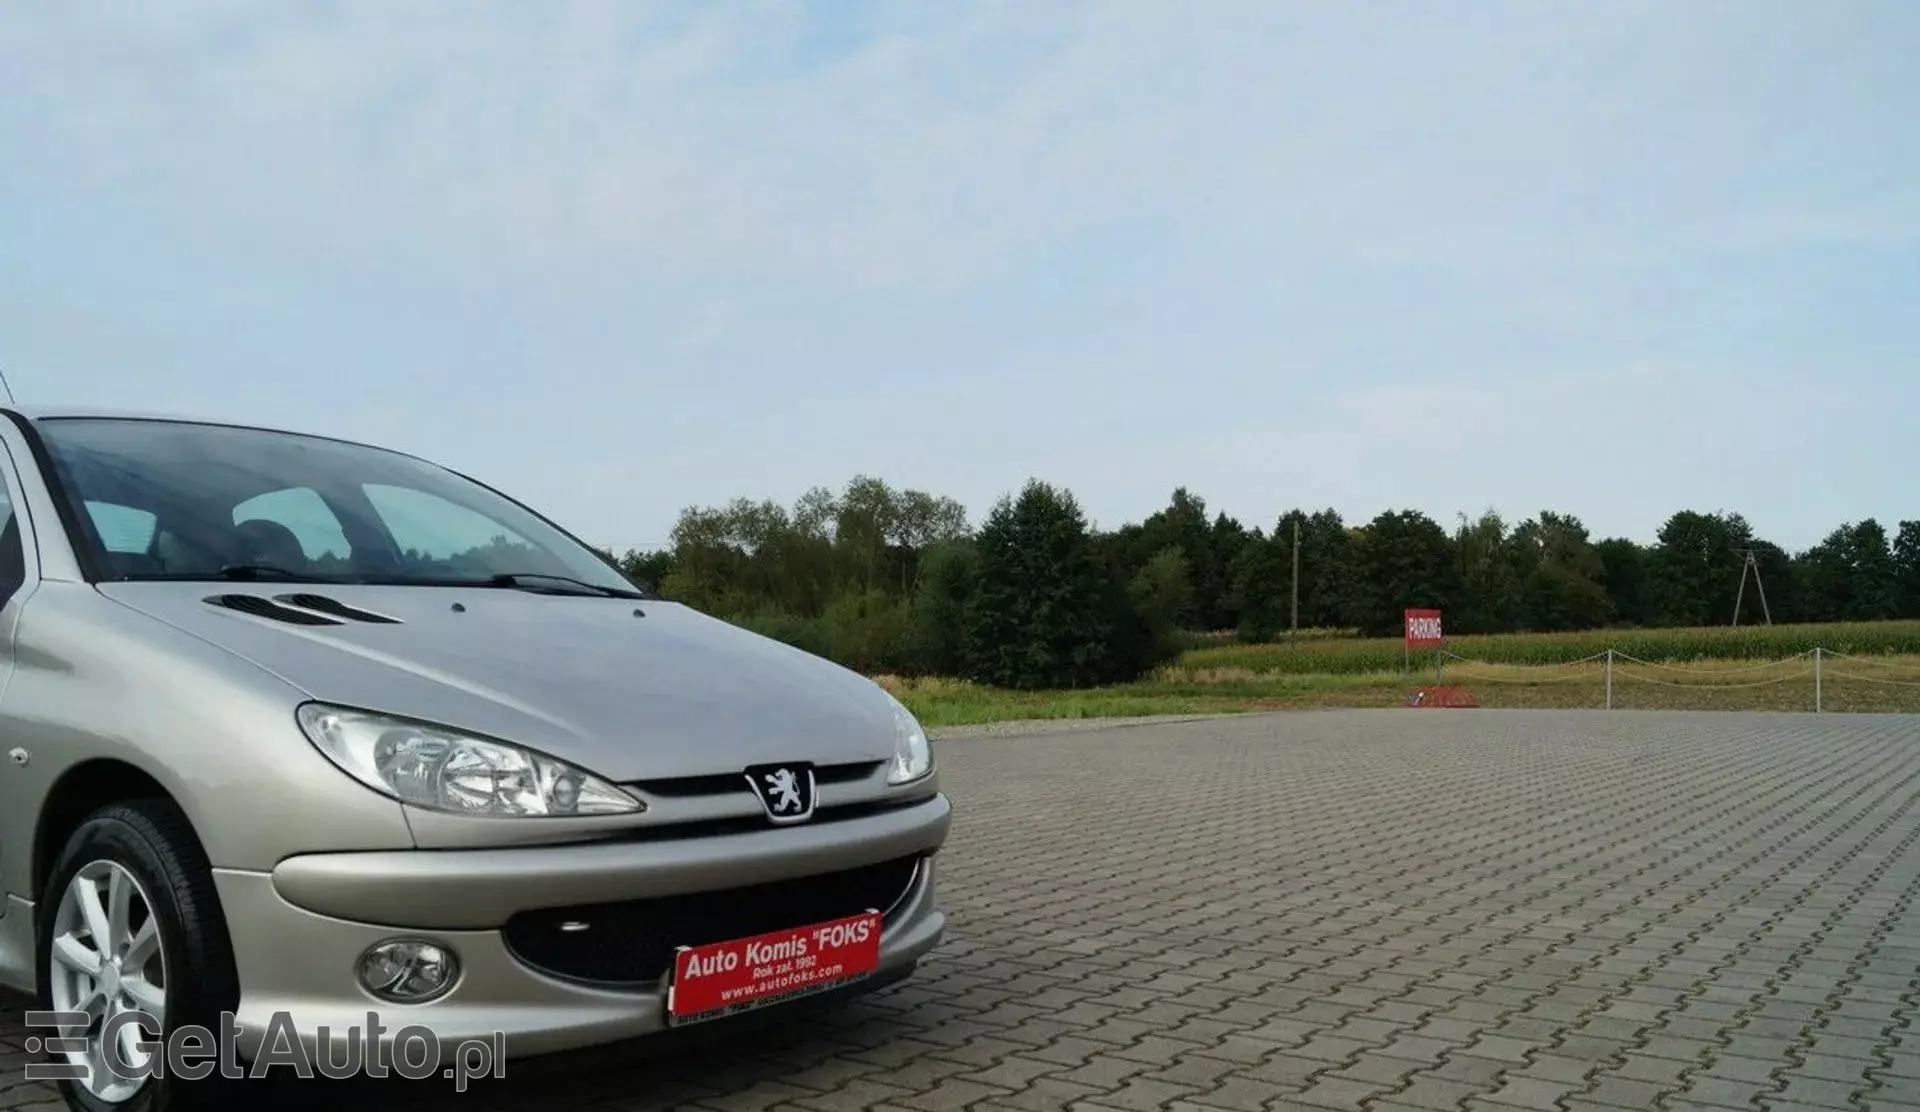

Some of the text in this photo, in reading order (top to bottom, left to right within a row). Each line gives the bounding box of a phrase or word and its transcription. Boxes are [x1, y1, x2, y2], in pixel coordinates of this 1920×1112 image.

[1409, 617, 1441, 639] PARKING
[685, 917, 876, 980] Auto Komis "FOKS"
[720, 962, 843, 1001] www.autofoks.com
[753, 965, 774, 980] Rok
[795, 954, 817, 970] 1992
